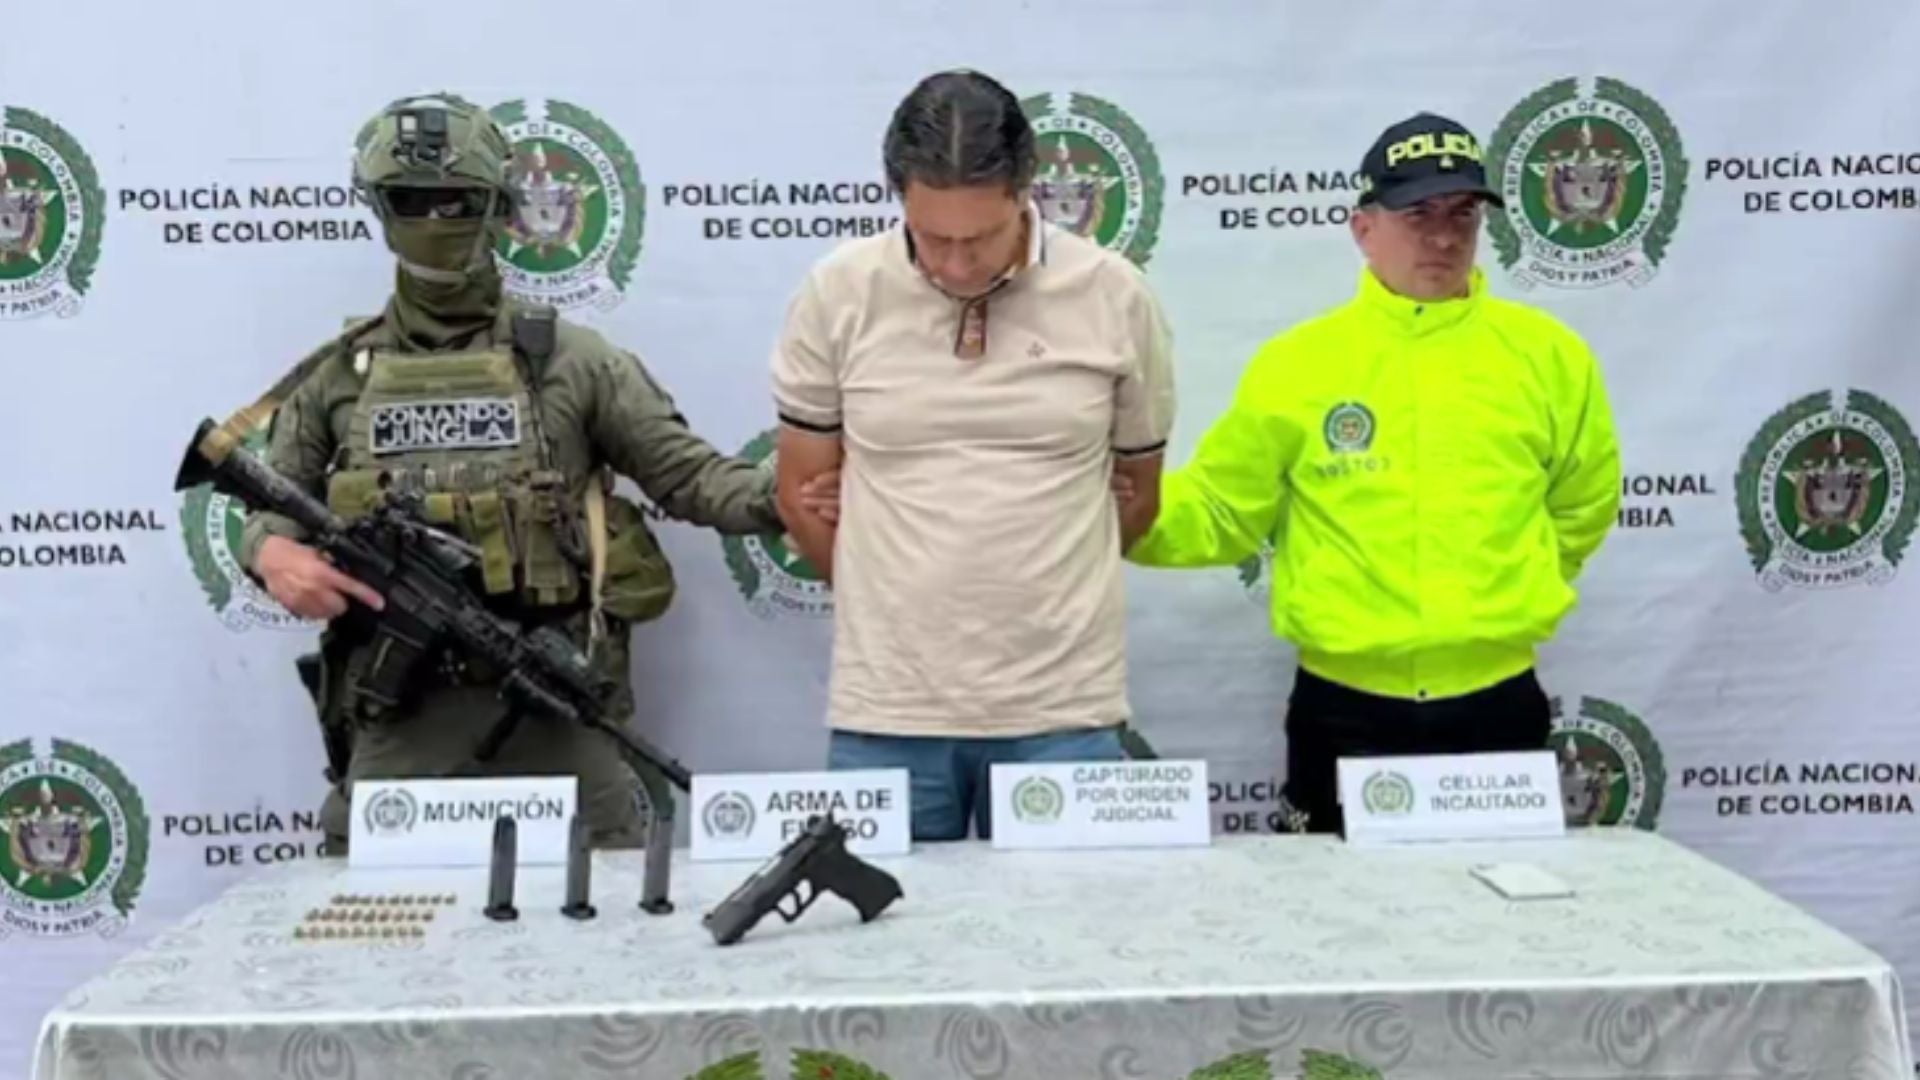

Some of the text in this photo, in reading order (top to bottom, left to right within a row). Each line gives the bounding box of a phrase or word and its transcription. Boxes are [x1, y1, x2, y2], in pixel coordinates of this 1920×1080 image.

[1705, 151, 1822, 181] POLICÍA
[662, 178, 781, 206] POLICÍA
[1182, 167, 1298, 196] POLICÍA
[118, 183, 241, 210] POLICÍA
[1744, 187, 1920, 213] DE COLOMB
[703, 217, 742, 239] DE
[1220, 205, 1349, 229] DE COLO
[164, 219, 372, 243] DE COLOMBIA
[374, 402, 514, 428] COMANDO
[382, 420, 506, 447] JUNGLA
[11, 510, 165, 533] NACIONAL
[1618, 507, 1675, 528] BIA
[1072, 766, 1193, 783] CAPTURADO
[1438, 773, 1533, 791] CELULAR
[1682, 760, 1920, 788] POLICÍA NACION
[766, 788, 892, 812] ARMA DE
[1076, 785, 1190, 803] POR ORDEN
[1431, 793, 1546, 811] INCAUTADO
[1717, 794, 1914, 816] DE COLOMBIA
[424, 792, 564, 822] MUNICIÓN
[1090, 805, 1178, 822] JUDICIAL
[164, 804, 284, 836] POLICÍA
[1222, 811, 1259, 833] DE
[205, 845, 244, 867] DE
